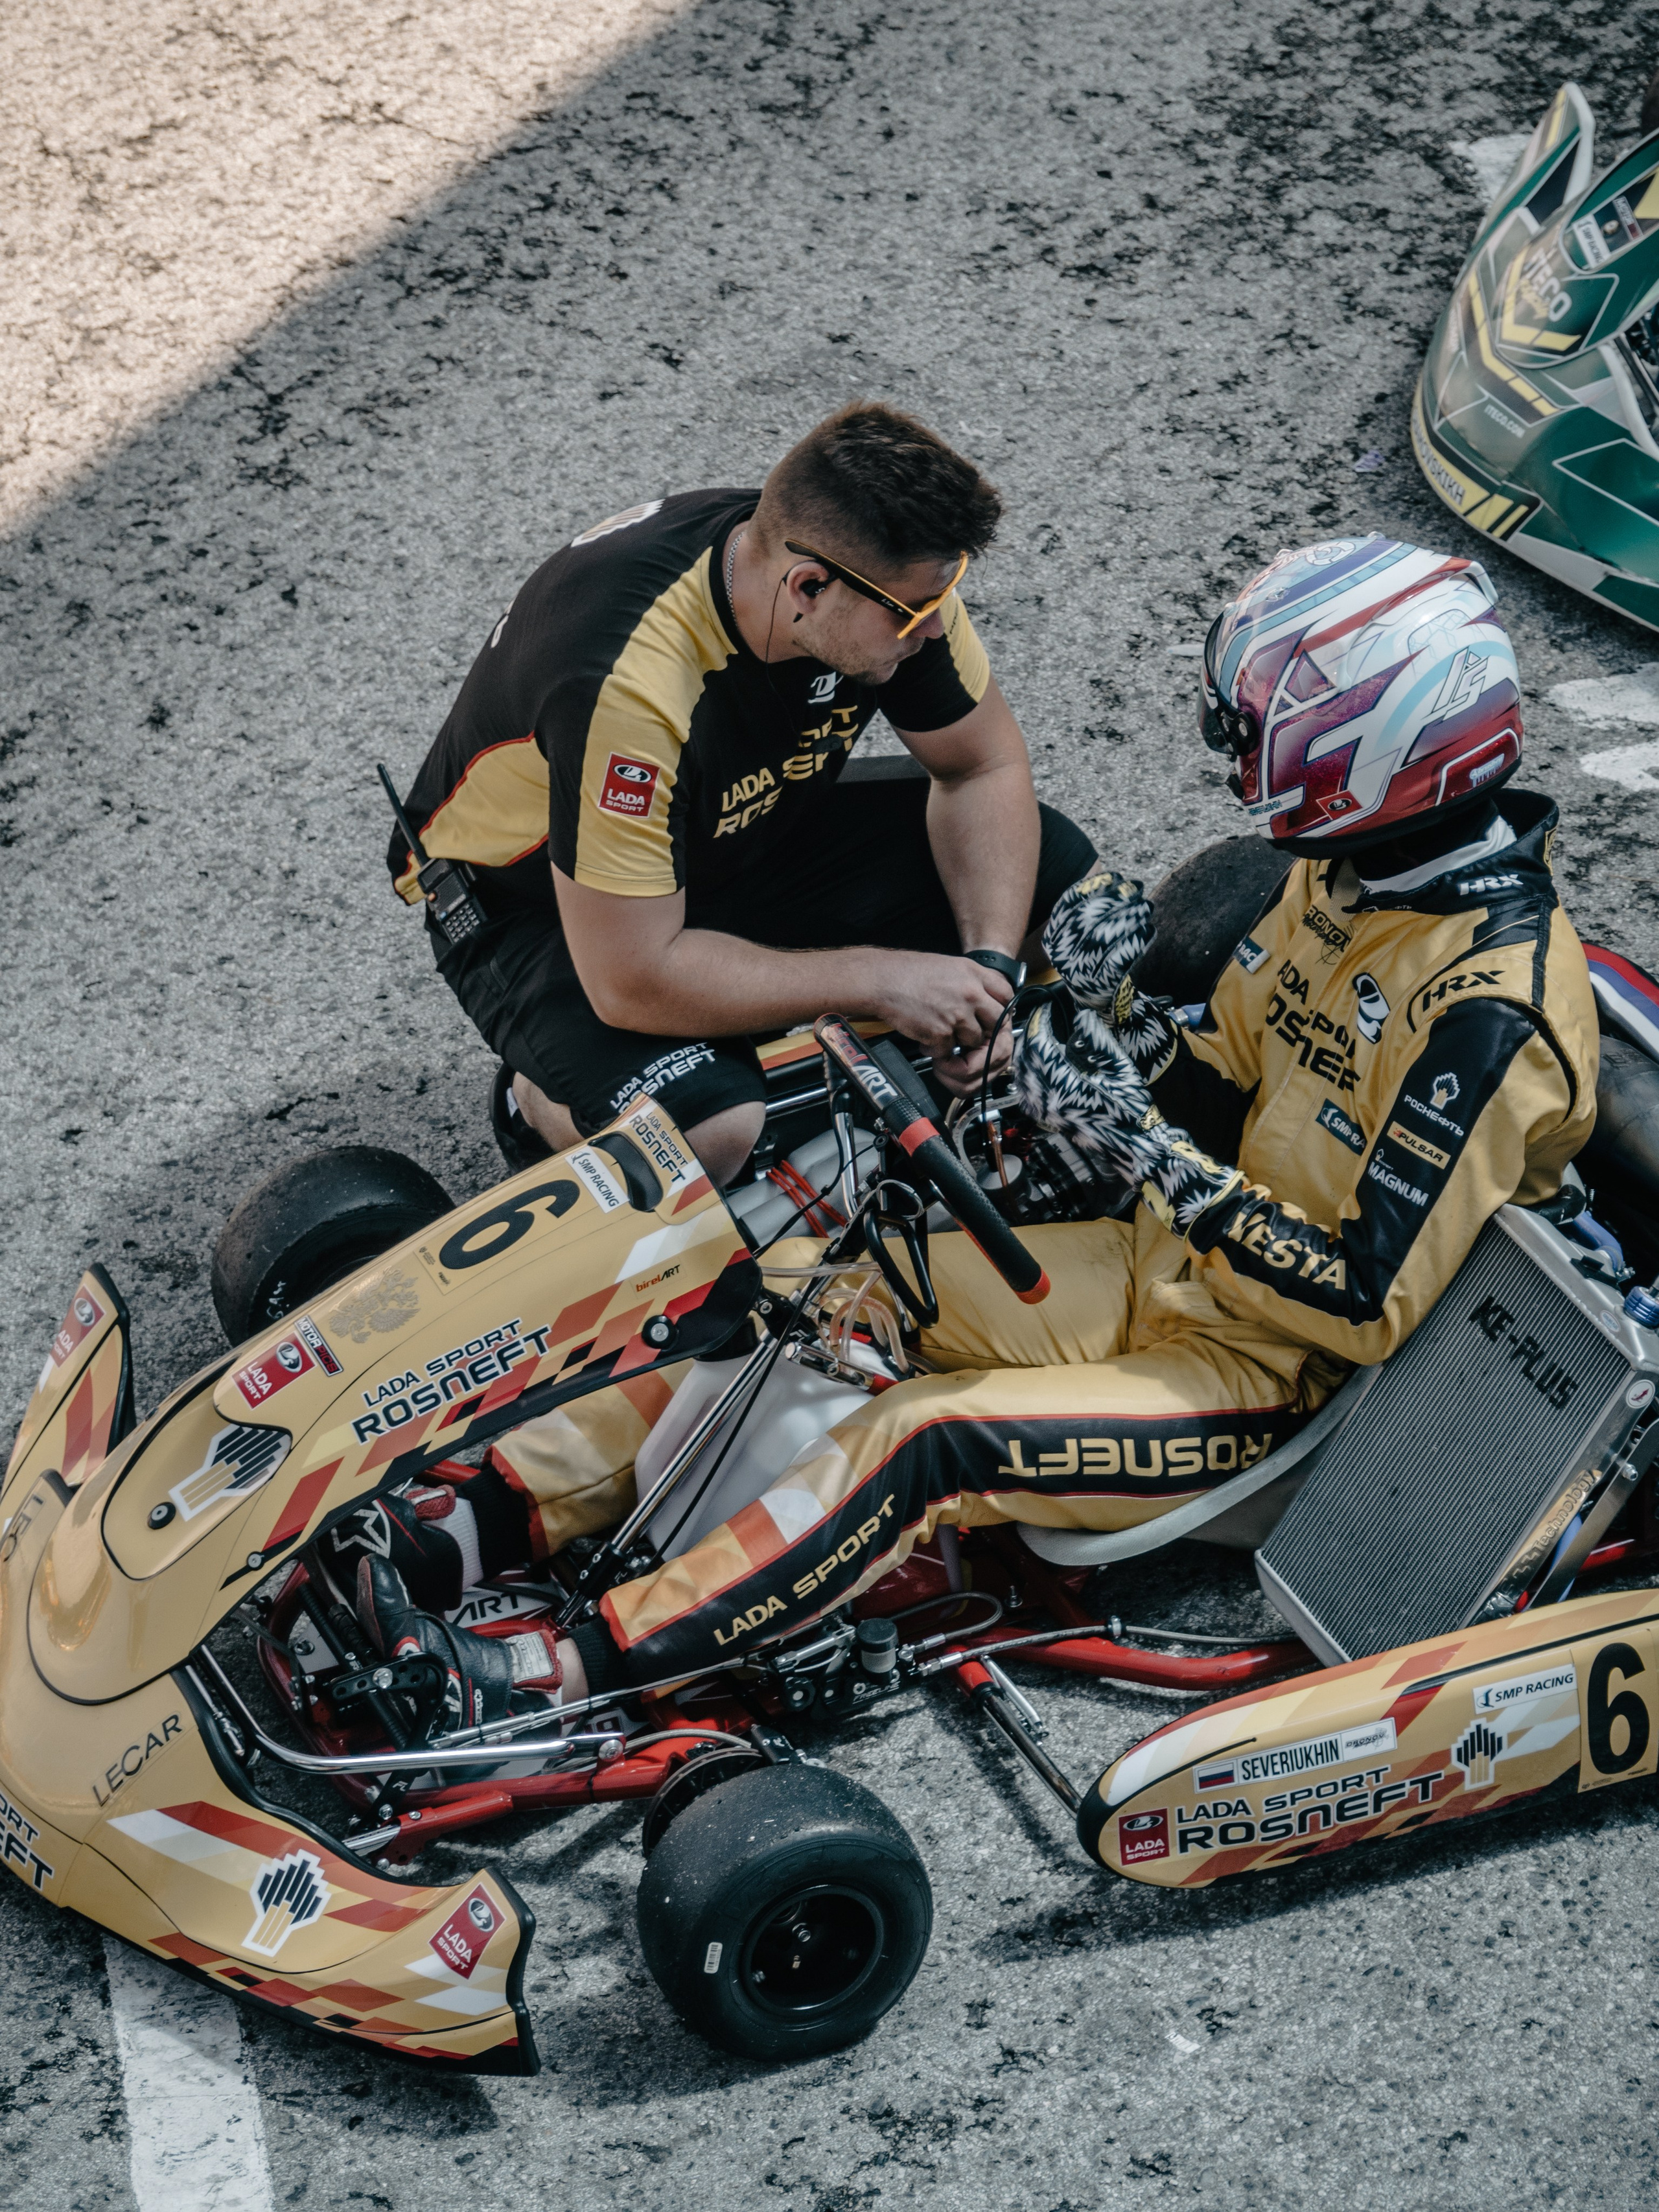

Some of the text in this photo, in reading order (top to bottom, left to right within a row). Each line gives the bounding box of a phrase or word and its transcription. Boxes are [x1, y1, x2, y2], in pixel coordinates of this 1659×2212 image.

[606, 800, 644, 812] SPORT
[607, 788, 645, 806] LADA
[722, 767, 776, 812] LADA
[1459, 874, 1524, 896] HRX
[1277, 959, 1310, 1005] ADA
[1422, 970, 1507, 1012] HRX
[610, 1042, 708, 1109] LADA SPORT
[629, 1114, 686, 1183] ROSNEFT
[646, 1112, 688, 1166] LADA SPORT
[1330, 1117, 1352, 1137] SMP
[1398, 1133, 1444, 1162] PULSAR
[579, 1155, 620, 1209] SMP RACING
[1367, 1161, 1429, 1207] MAGNUM
[439, 1179, 580, 1269] 6
[1227, 1211, 1346, 1290] VESTA
[636, 1264, 680, 1293] birelART
[298, 1317, 338, 1373] MOTORPICS
[364, 1318, 523, 1408] LADA SPORT
[239, 1371, 262, 1399] SPORT
[247, 1361, 272, 1395] LADA
[352, 1326, 551, 1445] ROSNEFT
[998, 1433, 1272, 1477] ROSNEFT
[1531, 1469, 1597, 1552] Technology
[713, 1493, 896, 1646] LADA SPORT
[1495, 1673, 1574, 1704] SMP RACING
[1587, 1642, 1649, 1775] 6
[91, 1714, 183, 1807] LECAR
[1241, 1738, 1340, 1781] SEVERIUKHIN
[1178, 1765, 1391, 1822] LADA SPORT
[1178, 1771, 1444, 1855] ROSNEFT
[1124, 1837, 1165, 1855] LADA
[1126, 1848, 1165, 1861] SPORT
[437, 1936, 469, 1972] SPORT
[443, 1924, 473, 1962] LADA
